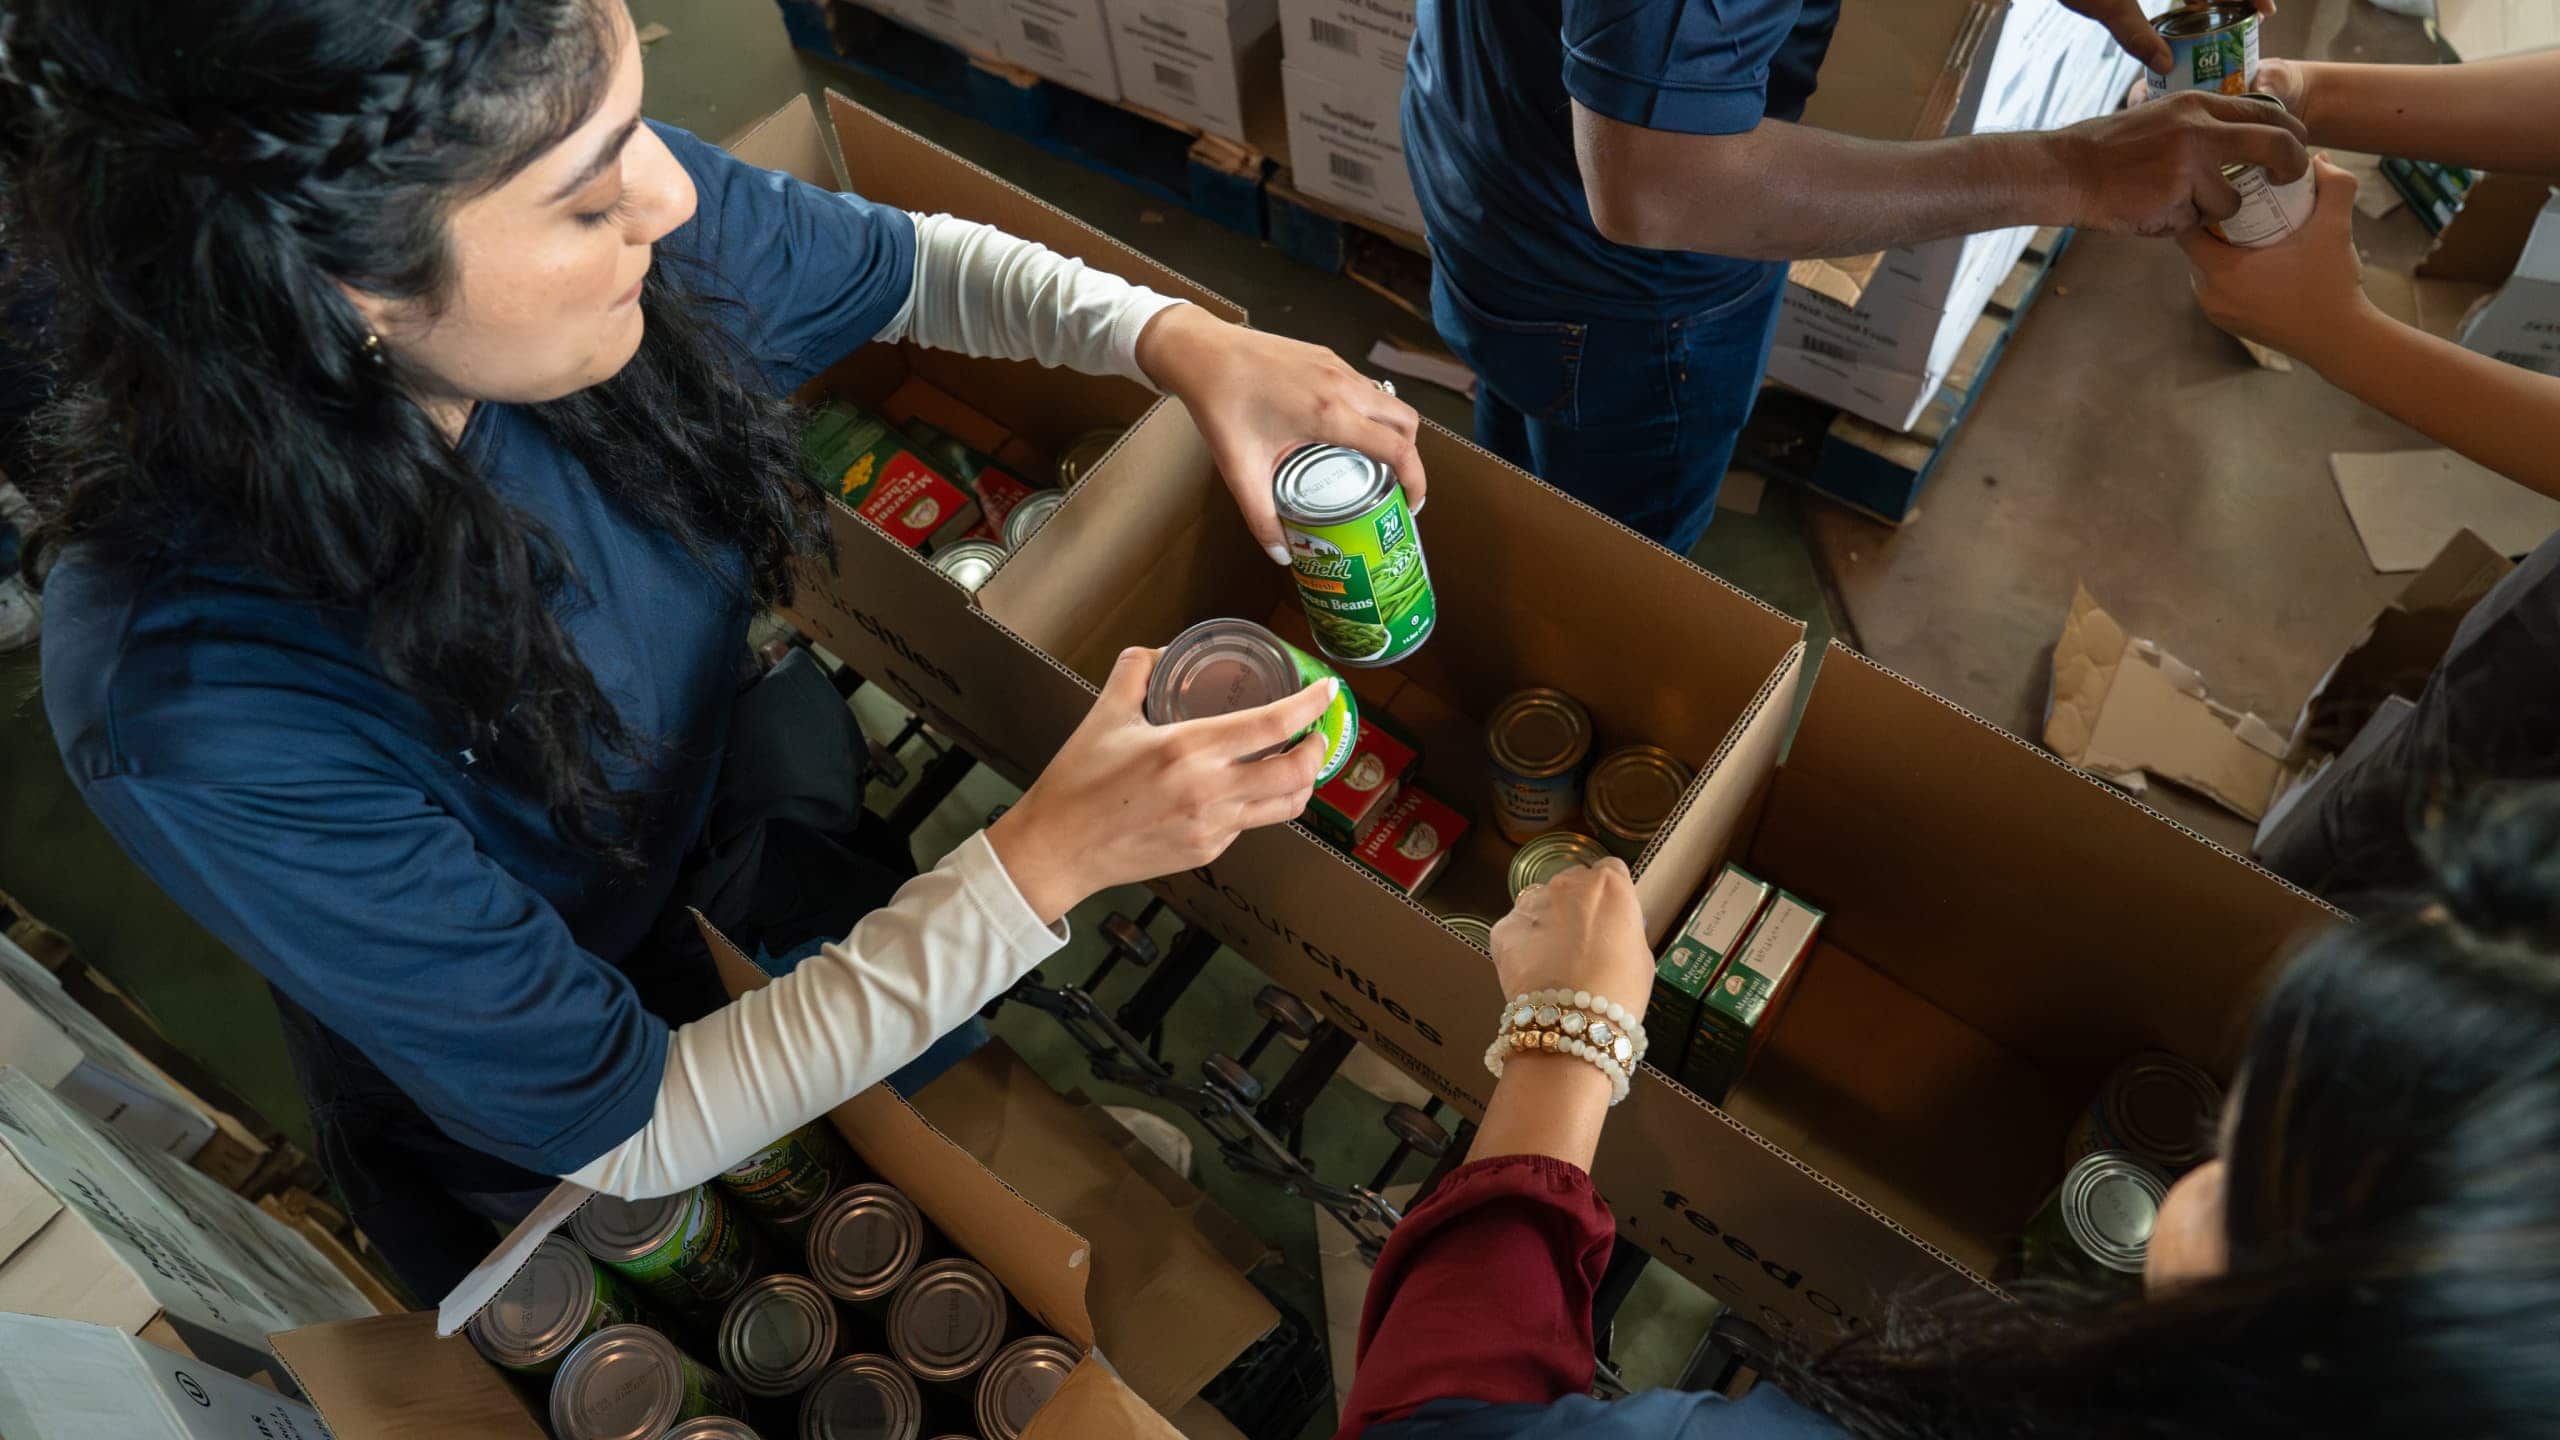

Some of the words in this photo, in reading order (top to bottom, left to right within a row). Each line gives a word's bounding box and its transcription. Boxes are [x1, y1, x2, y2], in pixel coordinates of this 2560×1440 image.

[2198, 52, 2220, 68] 60
[873, 473, 933, 525] Macaroni
[1383, 515, 1399, 539] 20
[1331, 598, 1374, 611] Beans
